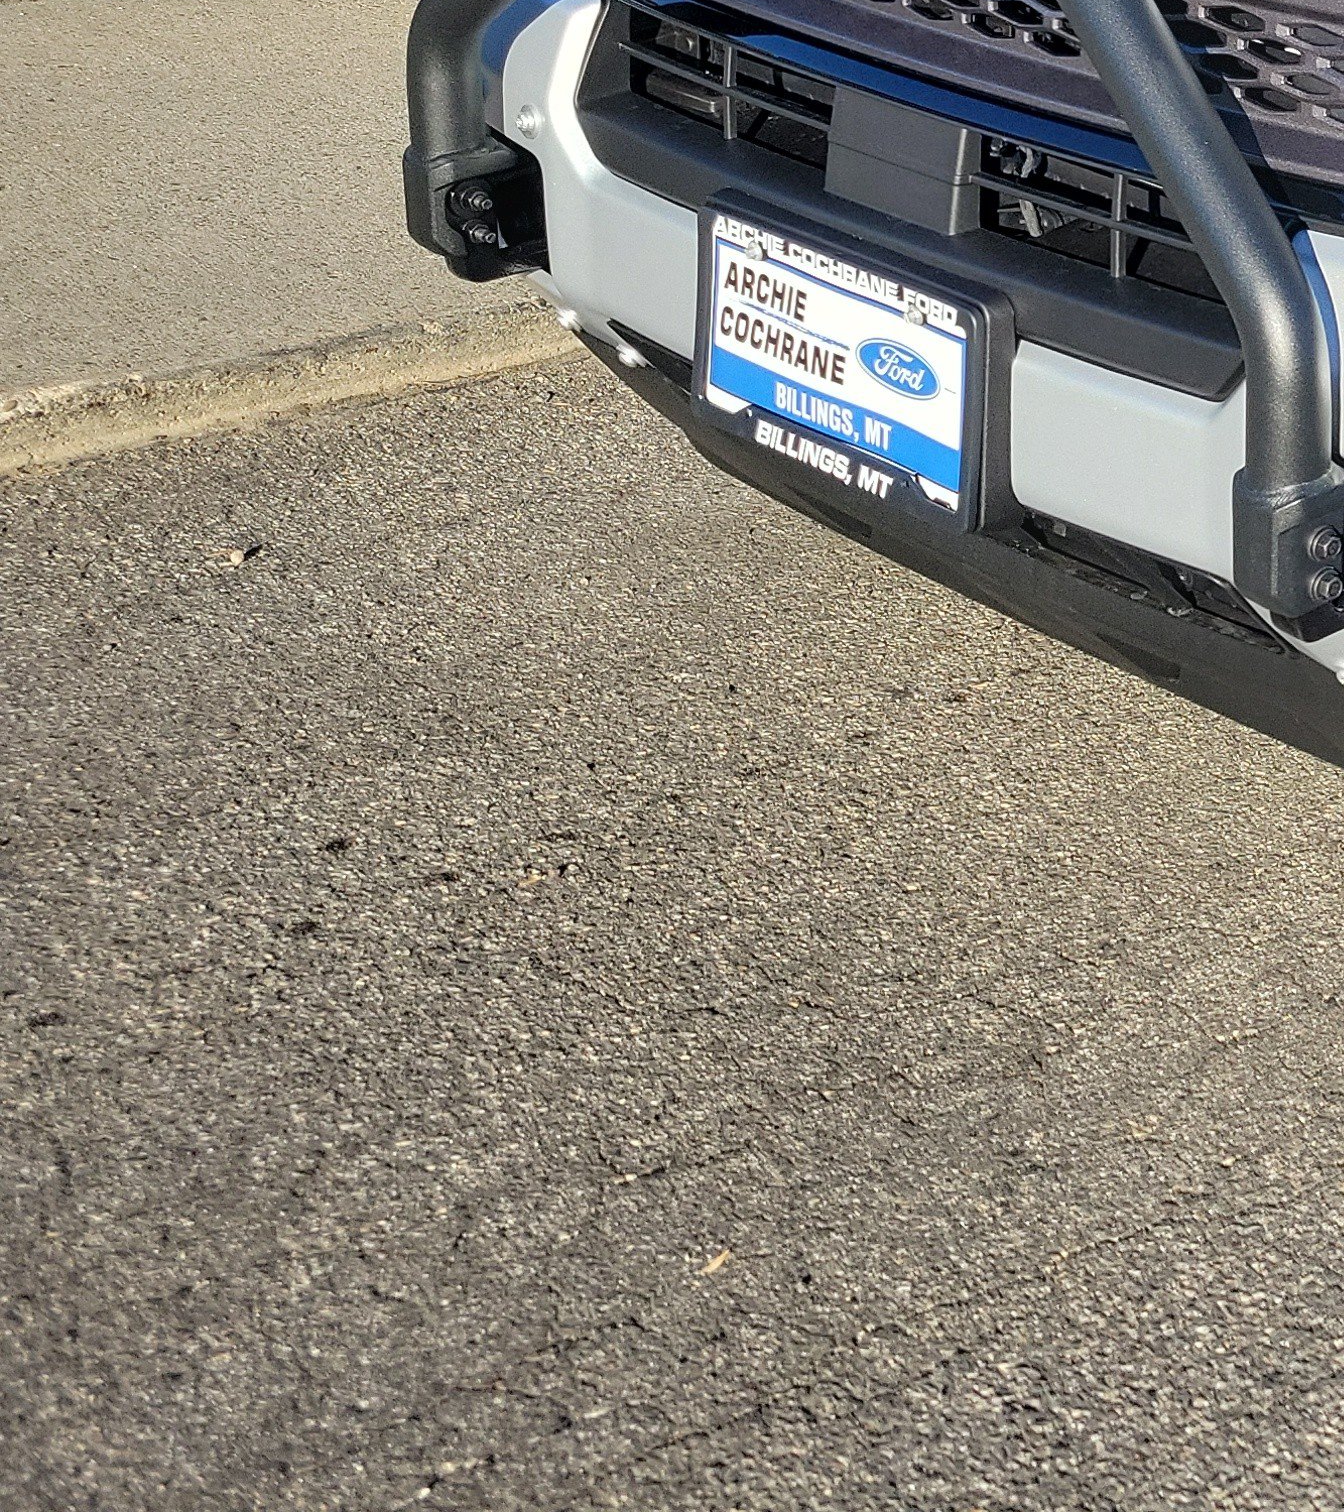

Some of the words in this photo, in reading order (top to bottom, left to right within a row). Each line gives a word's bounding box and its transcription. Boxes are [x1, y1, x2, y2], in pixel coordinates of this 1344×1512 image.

[712, 215, 784, 259] ARCHIE
[788, 242, 901, 298] COCHRANE
[901, 287, 958, 327] FORD
[724, 261, 808, 322] ARCHIE
[719, 305, 848, 385] COCHRANE
[874, 345, 925, 392] Ford
[775, 382, 861, 443] BILLINGS,
[865, 416, 892, 451] MT
[755, 419, 853, 486] BILLINGS,
[857, 464, 894, 499] MT
